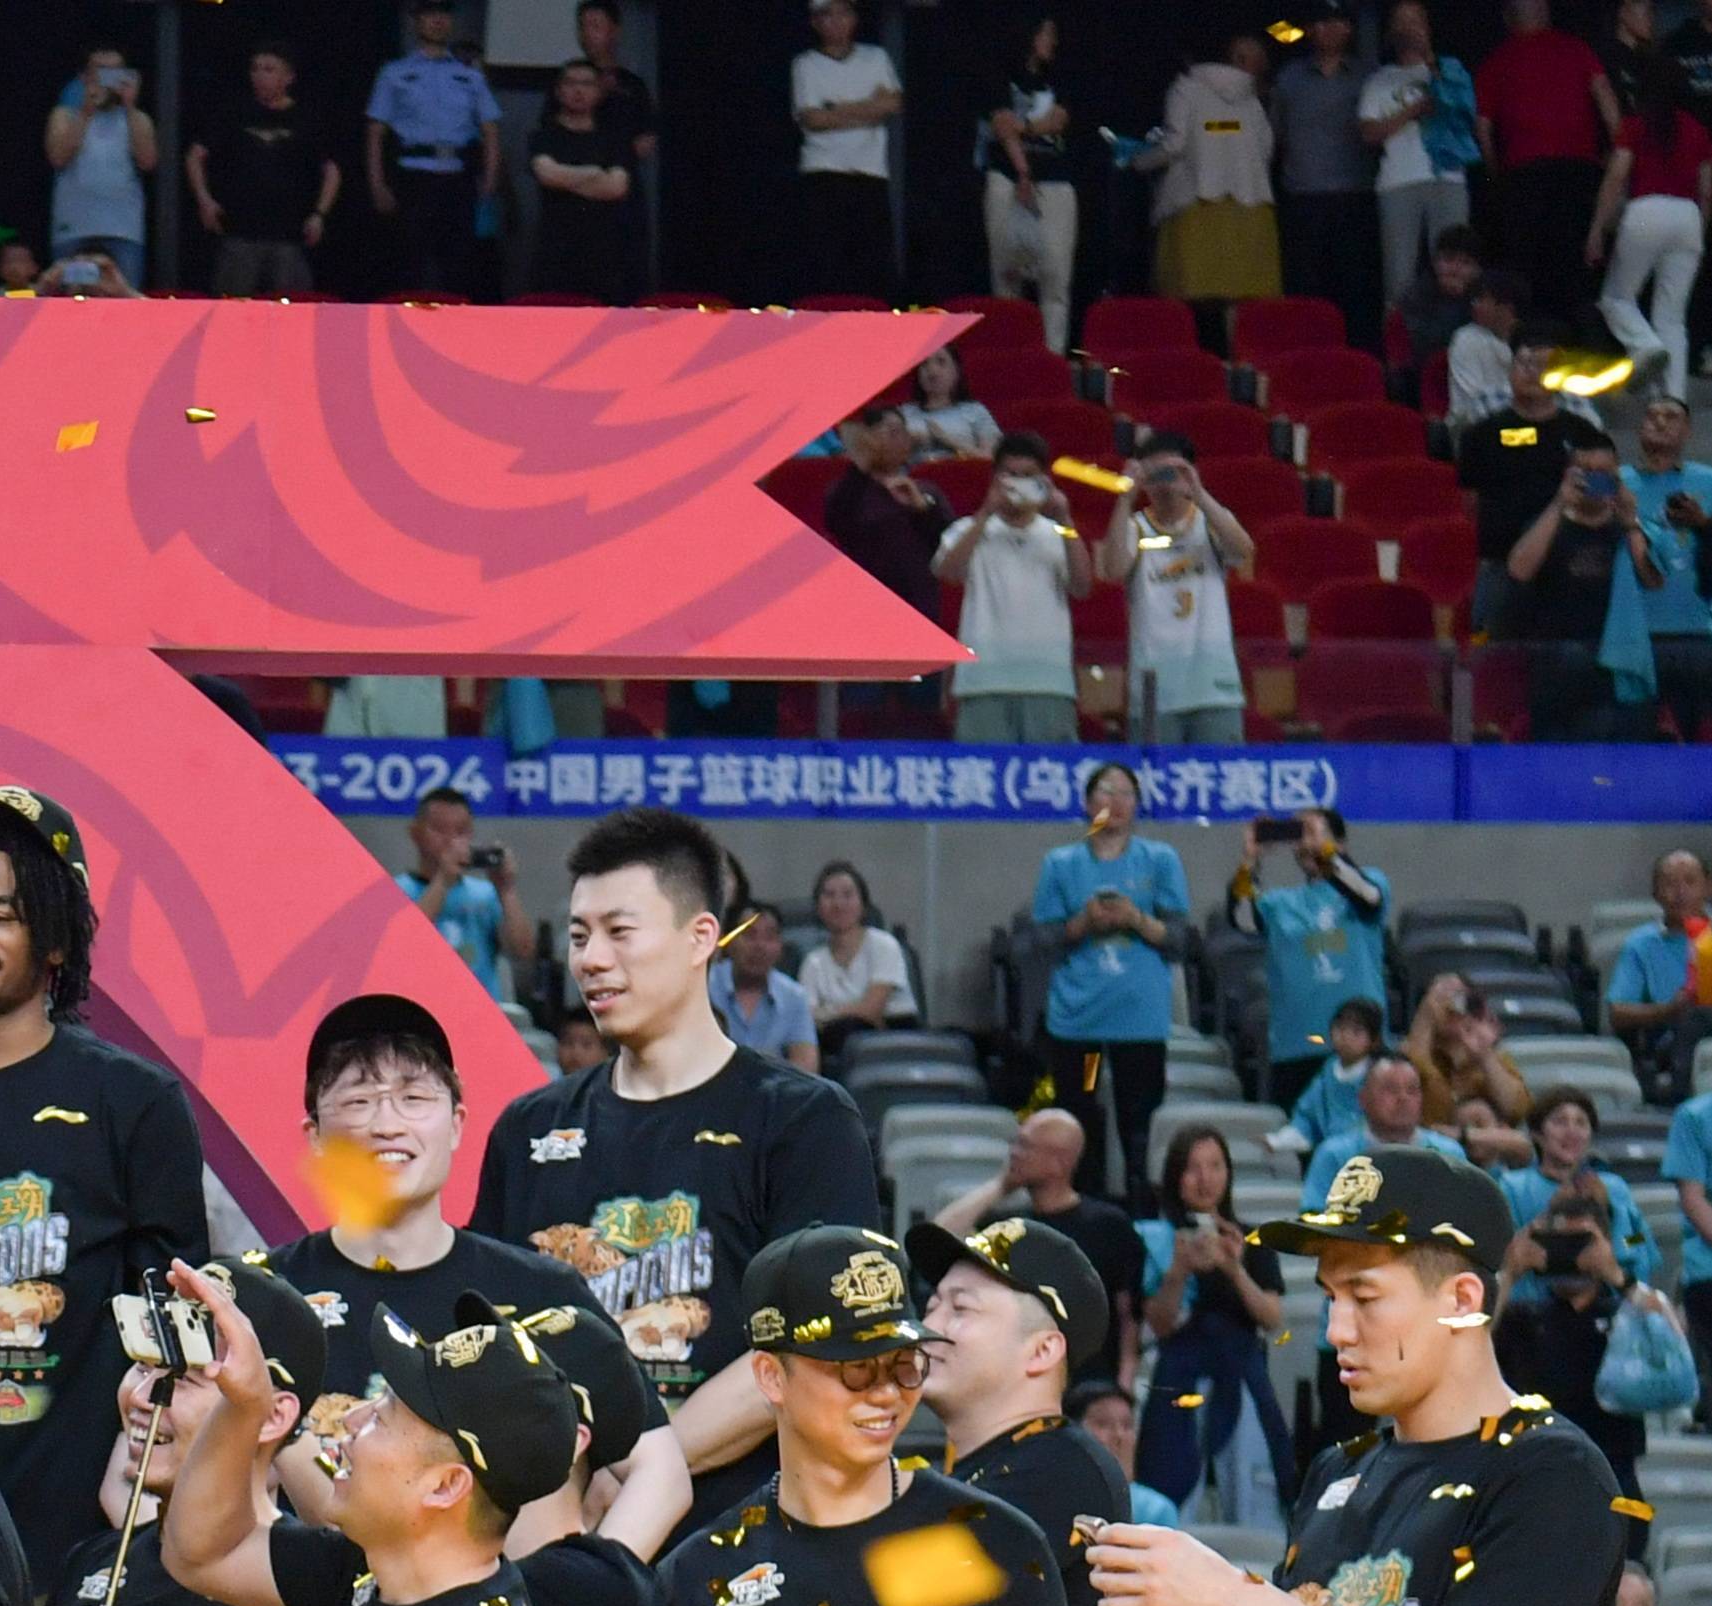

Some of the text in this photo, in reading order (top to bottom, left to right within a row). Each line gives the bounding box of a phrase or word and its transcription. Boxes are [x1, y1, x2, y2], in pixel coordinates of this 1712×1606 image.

[505, 754, 1337, 811] 中国男子篮球职业联赛(乌木齐赛区)
